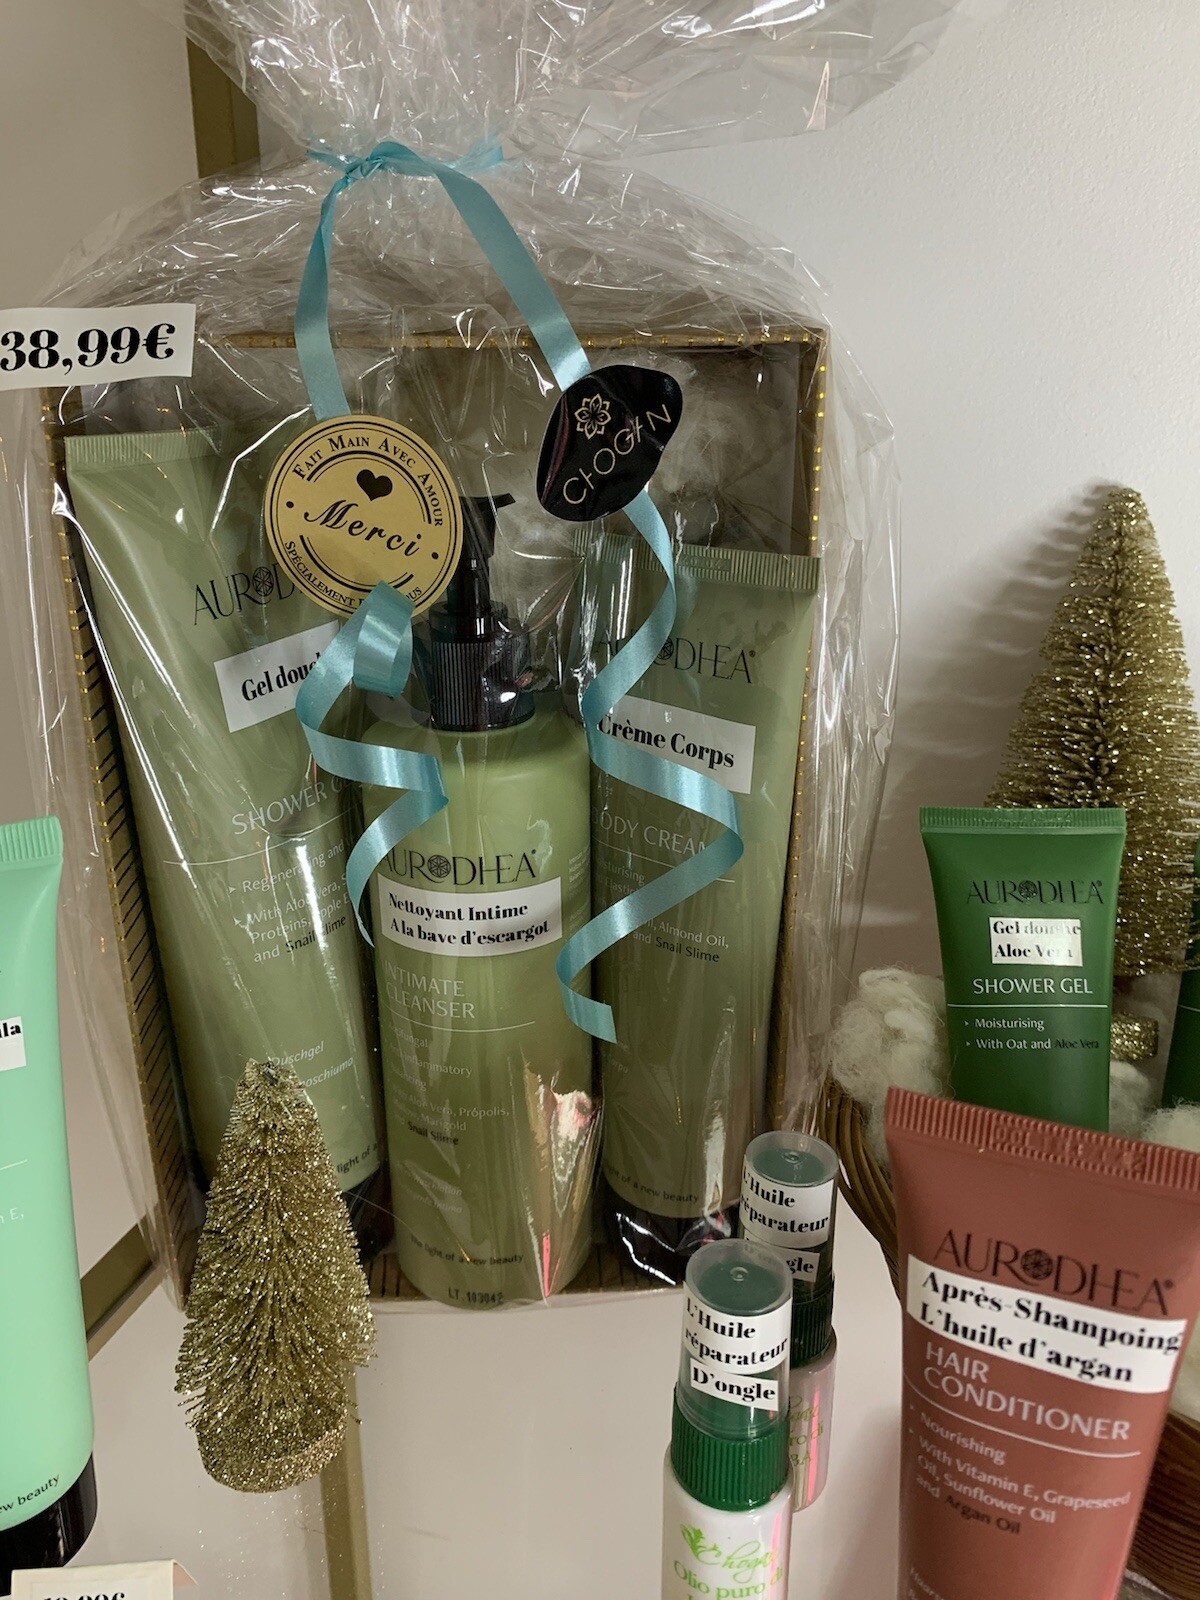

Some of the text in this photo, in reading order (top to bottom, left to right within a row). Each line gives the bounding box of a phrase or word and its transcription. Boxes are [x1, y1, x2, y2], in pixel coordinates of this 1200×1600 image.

[0, 322, 176, 374] 38,99€
[292, 434, 444, 527] FAIT MAIN AVEC AMOUR
[303, 499, 422, 557] Merci
[193, 563, 304, 626] AUROD
[241, 651, 320, 701] Gel dou
[600, 636, 752, 684] ODHEA
[598, 714, 735, 771] Crème Corps
[231, 781, 328, 835] SHOWER
[242, 851, 326, 893] Regeneraing
[966, 879, 1104, 905] AURODHEA
[318, 899, 342, 919] pple
[388, 892, 528, 922] Nettoyant Intime
[993, 920, 1080, 935] Gel doue
[254, 914, 347, 963] and Snail lime
[390, 917, 550, 945] A la bave d'escargot
[655, 936, 682, 955] Snail
[685, 946, 720, 963] Slime
[659, 920, 703, 943] Almond
[706, 934, 729, 949] Oil,
[994, 943, 1073, 958] Aloe Vea
[384, 960, 465, 997] INTIMATE
[973, 977, 1093, 995] SHOWER GEL
[385, 980, 476, 1020] CLEANSER
[975, 1017, 1045, 1031] Moisturising
[976, 1038, 1099, 1050] With Oat and Aloe Vera
[271, 1041, 325, 1067] Duschgel
[336, 1156, 360, 1174] light
[934, 1228, 1168, 1317] AURODHEA
[686, 1297, 756, 1339] L'Huile
[921, 1271, 1182, 1356] Après-Shampoing
[685, 1327, 788, 1366] réparateur
[919, 1301, 1133, 1383] L'huile d'argan
[925, 1341, 990, 1384] HAIR
[692, 1366, 776, 1403] D'ongle
[923, 1366, 1131, 1441] CONDITIONER
[920, 1411, 1007, 1466] Nourishing
[17, 1474, 60, 1506] beauty
[917, 1453, 1057, 1524] Oil, Sunflower Oil
[918, 1435, 1132, 1512] With Vitamin E, Grapeseed
[915, 1474, 1021, 1535] and Argan Oil
[673, 1559, 710, 1595] Olio
[716, 1582, 767, 1600] puro
